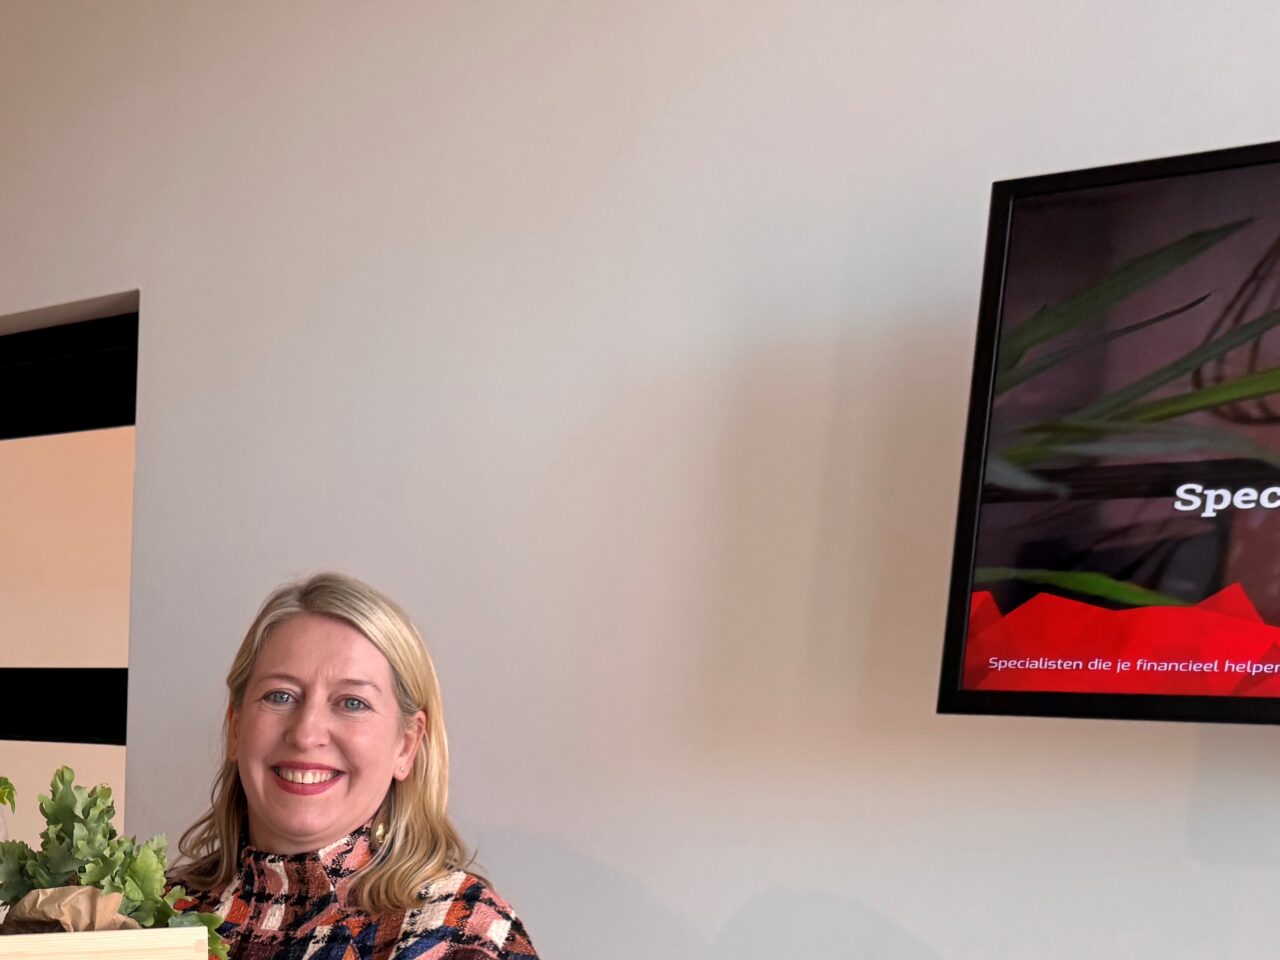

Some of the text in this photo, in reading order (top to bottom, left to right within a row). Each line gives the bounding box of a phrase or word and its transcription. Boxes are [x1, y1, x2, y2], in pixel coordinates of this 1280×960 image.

[988, 657, 1083, 671] Specialisten
[1087, 658, 1112, 671] die
[1116, 659, 1131, 673] je
[1136, 659, 1220, 673] financieel
